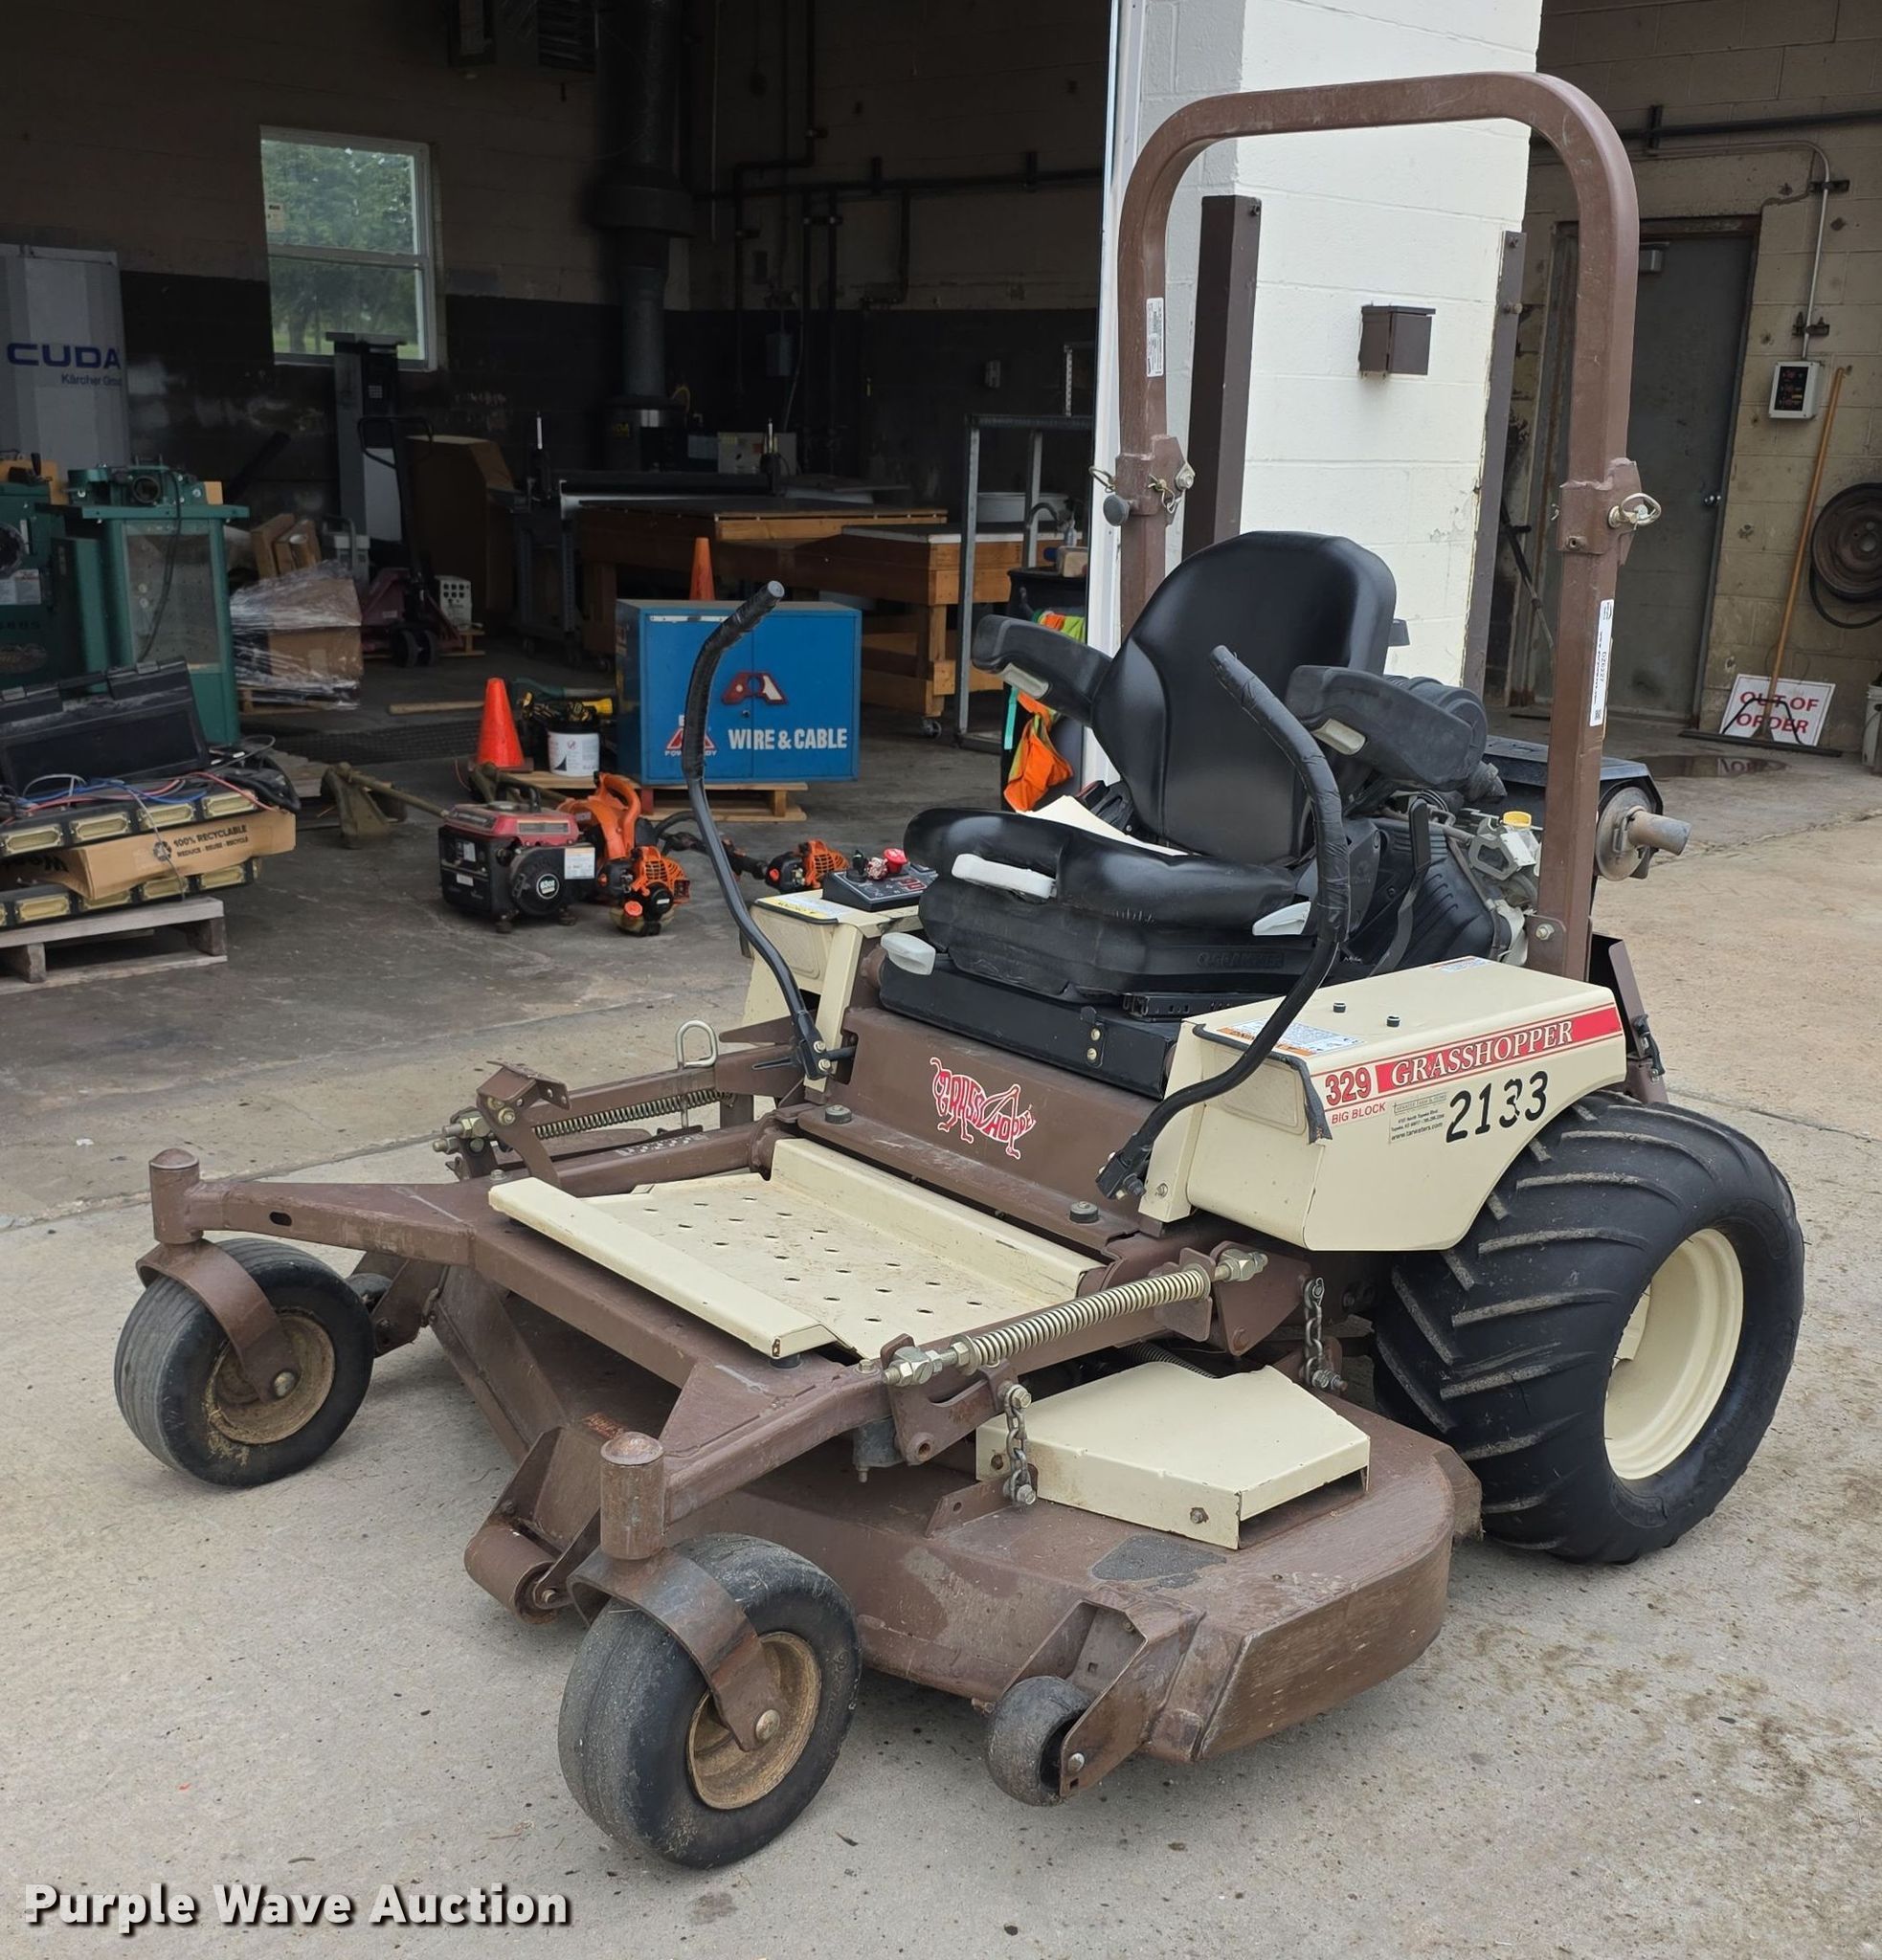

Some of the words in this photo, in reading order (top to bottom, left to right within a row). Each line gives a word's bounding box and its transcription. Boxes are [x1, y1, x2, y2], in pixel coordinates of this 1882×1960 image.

[7, 343, 122, 369] CUDA
[1790, 697, 1819, 712] OF
[1736, 713, 1809, 733] ORDER
[728, 728, 775, 750] WIRE
[777, 730, 792, 750] &
[794, 727, 848, 749] CABLE
[173, 836, 195, 848] 100%
[196, 824, 248, 842] RECYCLABLE
[1325, 1066, 1372, 1106] 329
[1391, 1019, 1574, 1086] GRASSHOPPER
[1332, 1111, 1349, 1125] BIG
[1352, 1102, 1386, 1120] BLOCK
[1445, 1070, 1548, 1144] 2133
